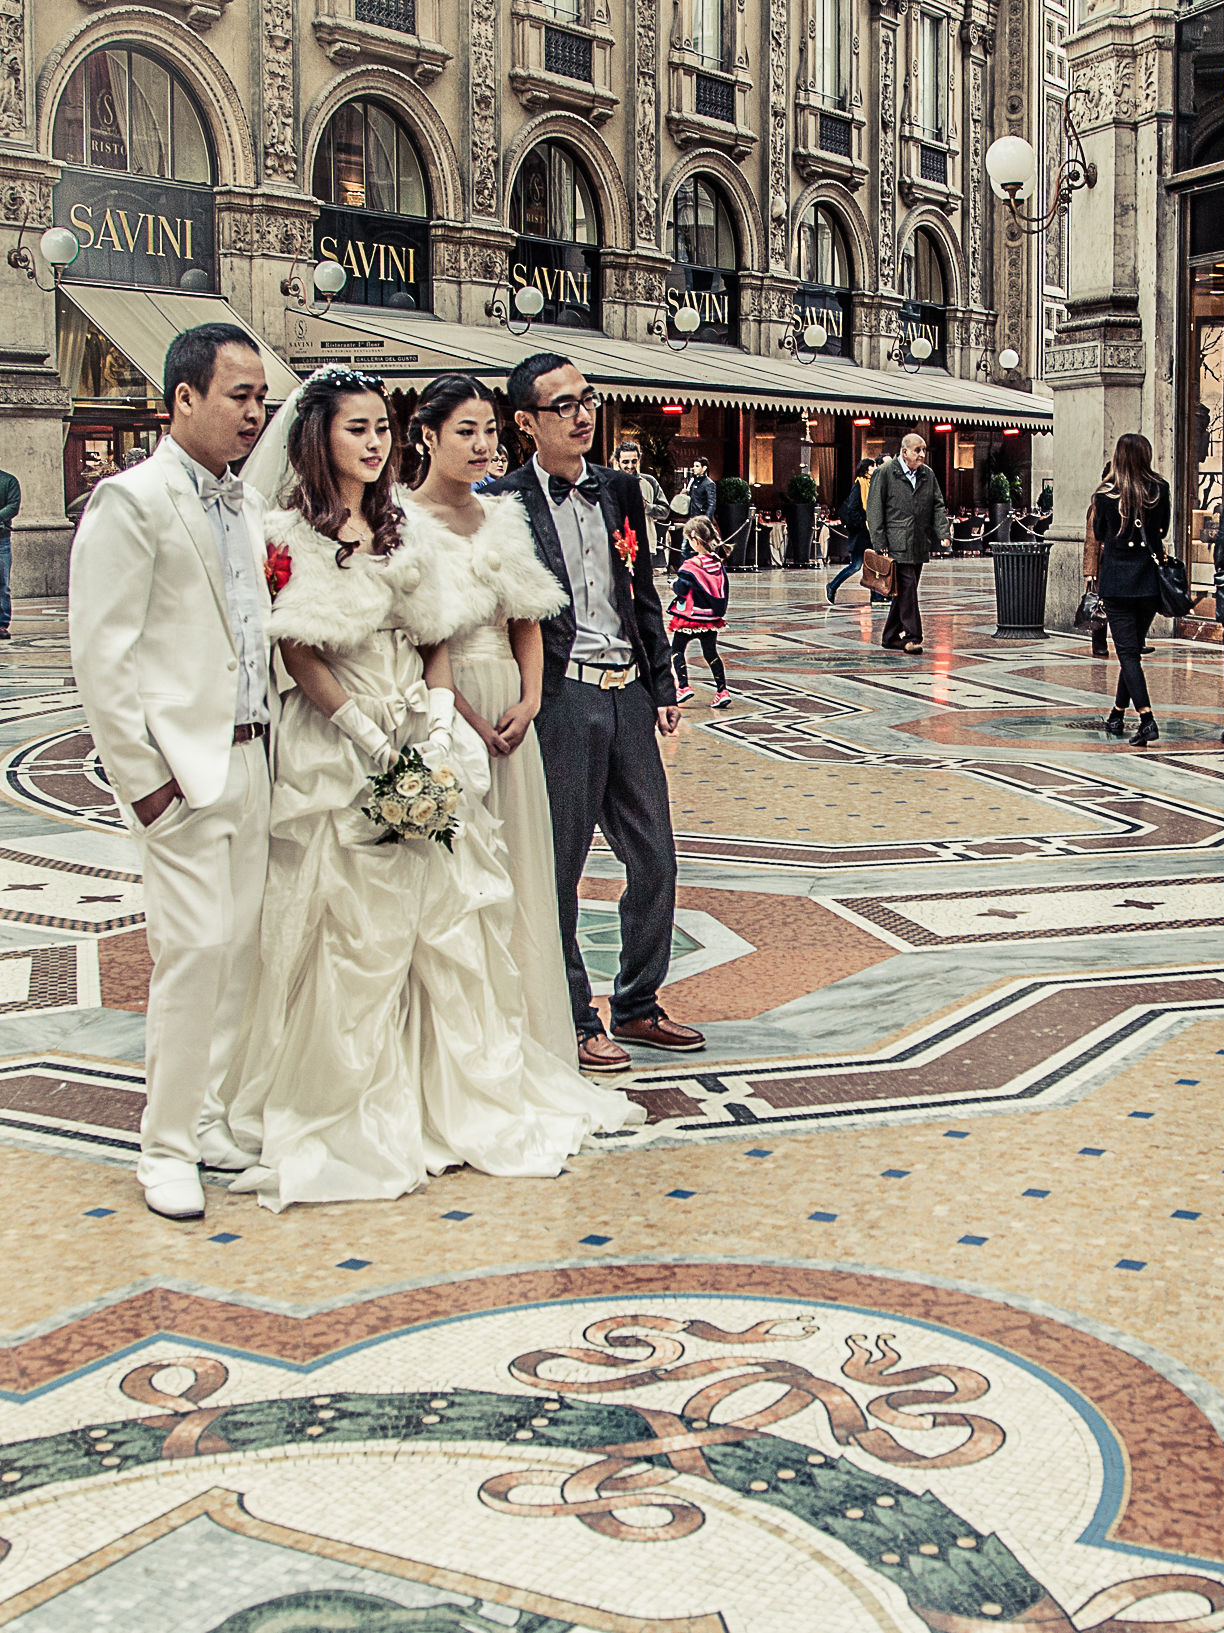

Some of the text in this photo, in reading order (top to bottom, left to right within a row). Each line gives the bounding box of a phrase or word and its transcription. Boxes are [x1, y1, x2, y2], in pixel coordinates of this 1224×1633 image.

[70, 203, 194, 260] SAVINI
[320, 236, 415, 284] SAVINI
[512, 263, 589, 305] SAVINI
[667, 287, 729, 325] SAVINI
[793, 303, 843, 338] SAVINI
[899, 320, 939, 350] SAVINI
